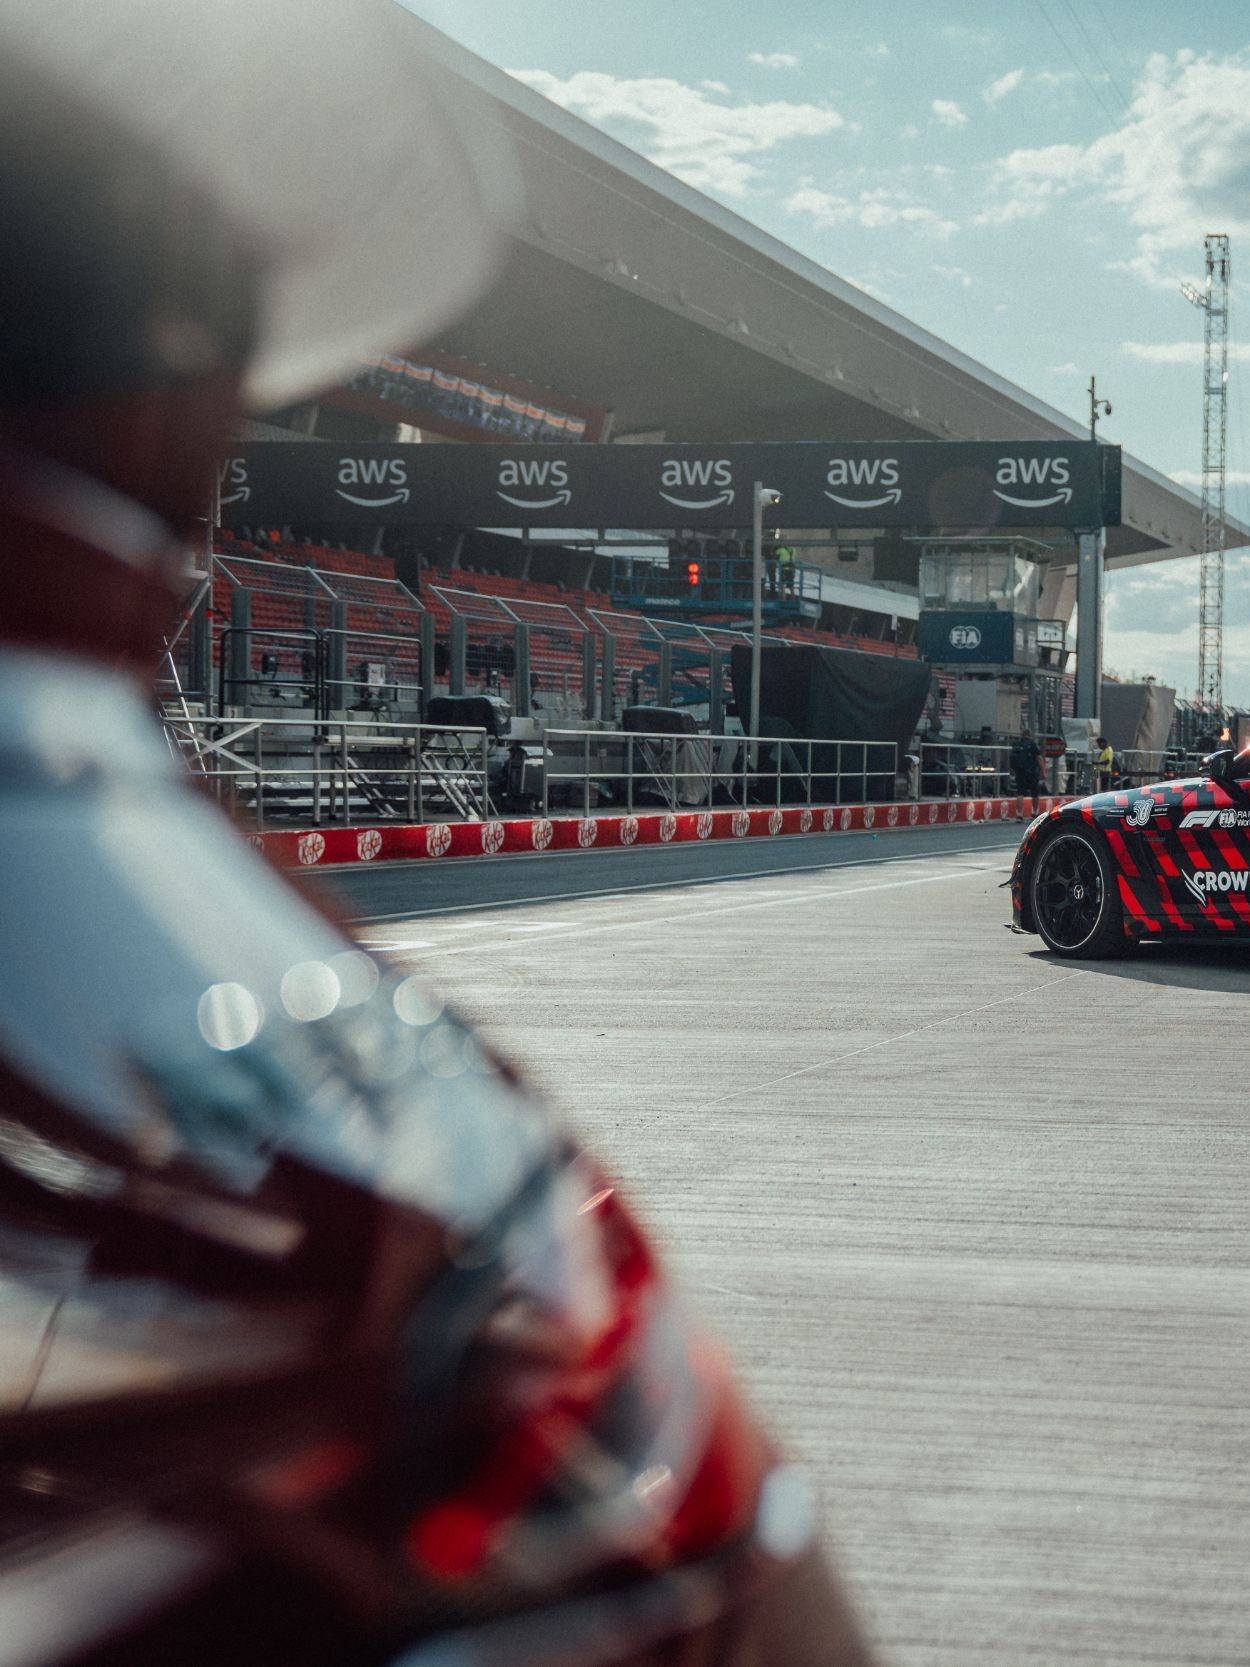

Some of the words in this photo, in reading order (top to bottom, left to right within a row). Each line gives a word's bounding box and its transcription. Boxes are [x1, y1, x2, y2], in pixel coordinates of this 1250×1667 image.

[338, 458, 407, 484] aws
[499, 460, 568, 486] aws
[661, 460, 732, 486] aws
[827, 459, 899, 485] aws
[996, 457, 1070, 484] aws
[951, 630, 979, 645] FIA
[1179, 810, 1221, 828] F1
[1219, 812, 1236, 825] FIA
